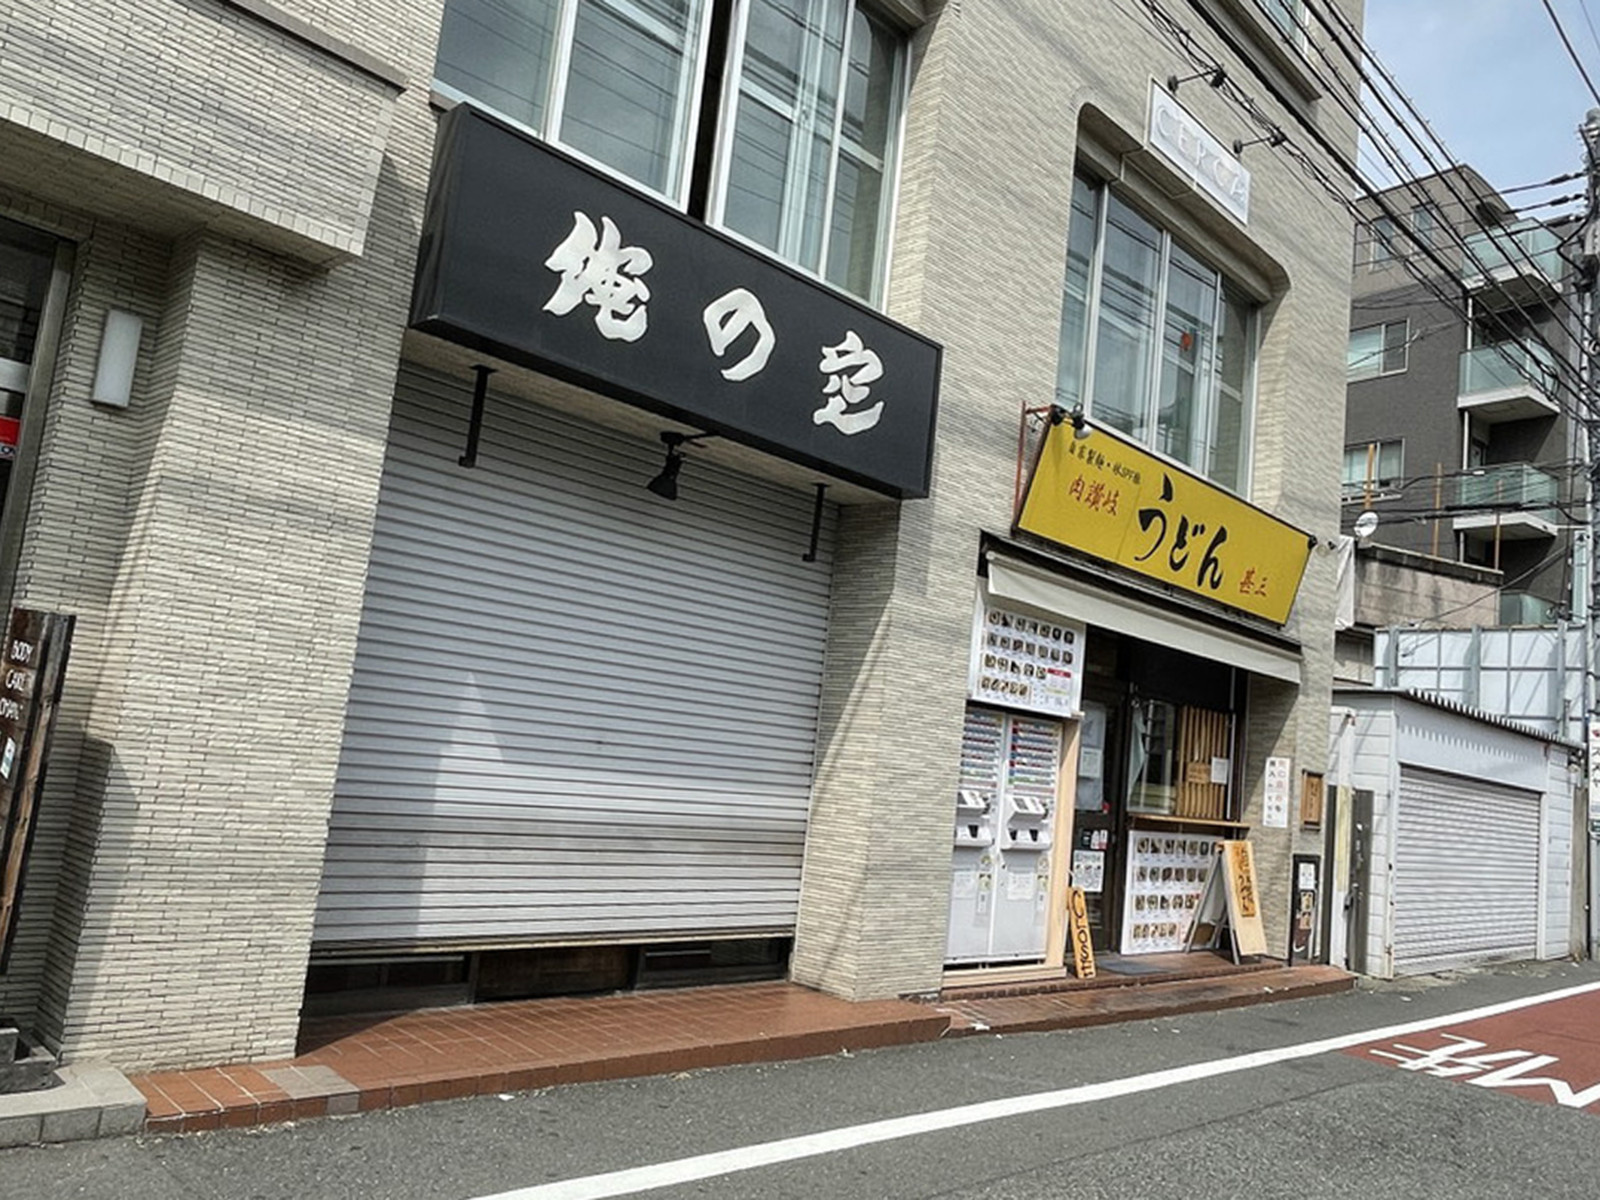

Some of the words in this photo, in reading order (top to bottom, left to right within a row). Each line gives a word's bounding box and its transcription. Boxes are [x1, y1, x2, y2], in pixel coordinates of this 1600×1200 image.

[1134, 472, 1227, 590] うどん
[10, 639, 34, 663] BODY
